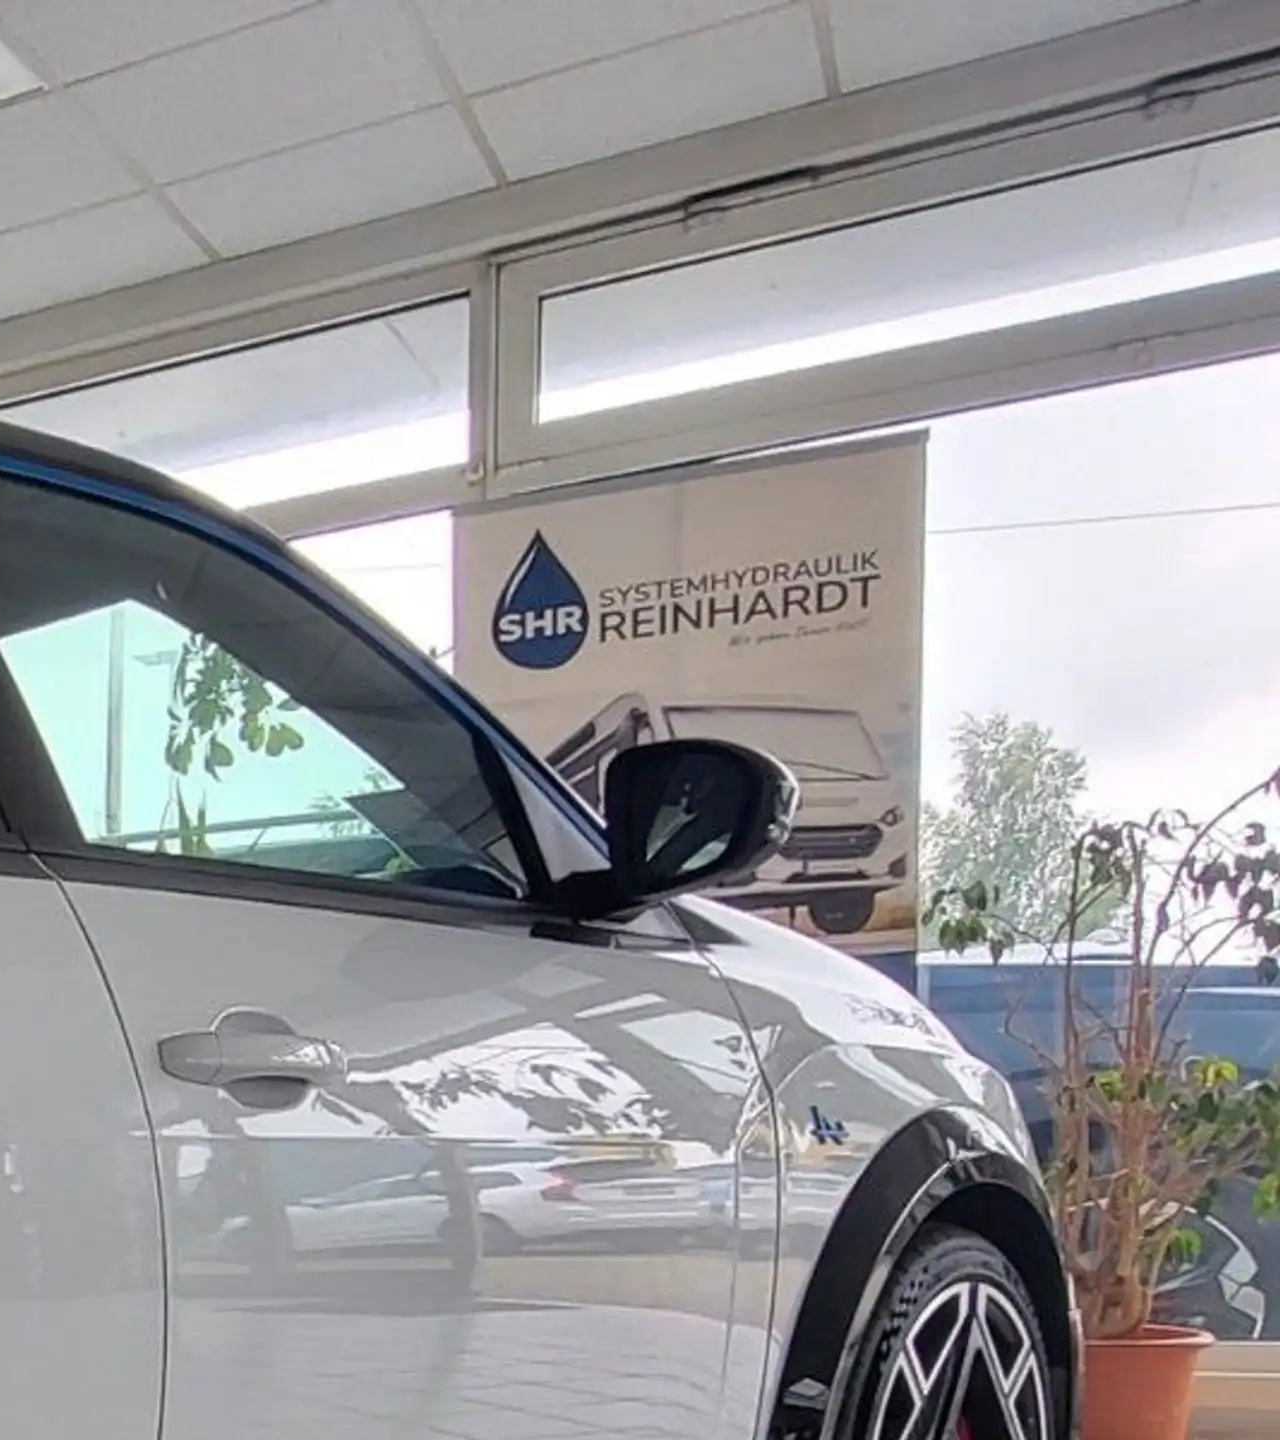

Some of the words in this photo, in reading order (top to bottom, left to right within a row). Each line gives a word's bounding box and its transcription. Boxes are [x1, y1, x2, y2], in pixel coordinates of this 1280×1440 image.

[598, 549, 880, 608] SYSTEMHYDRAULIK
[598, 573, 882, 643] REINHARDT
[499, 604, 585, 643] SHR
